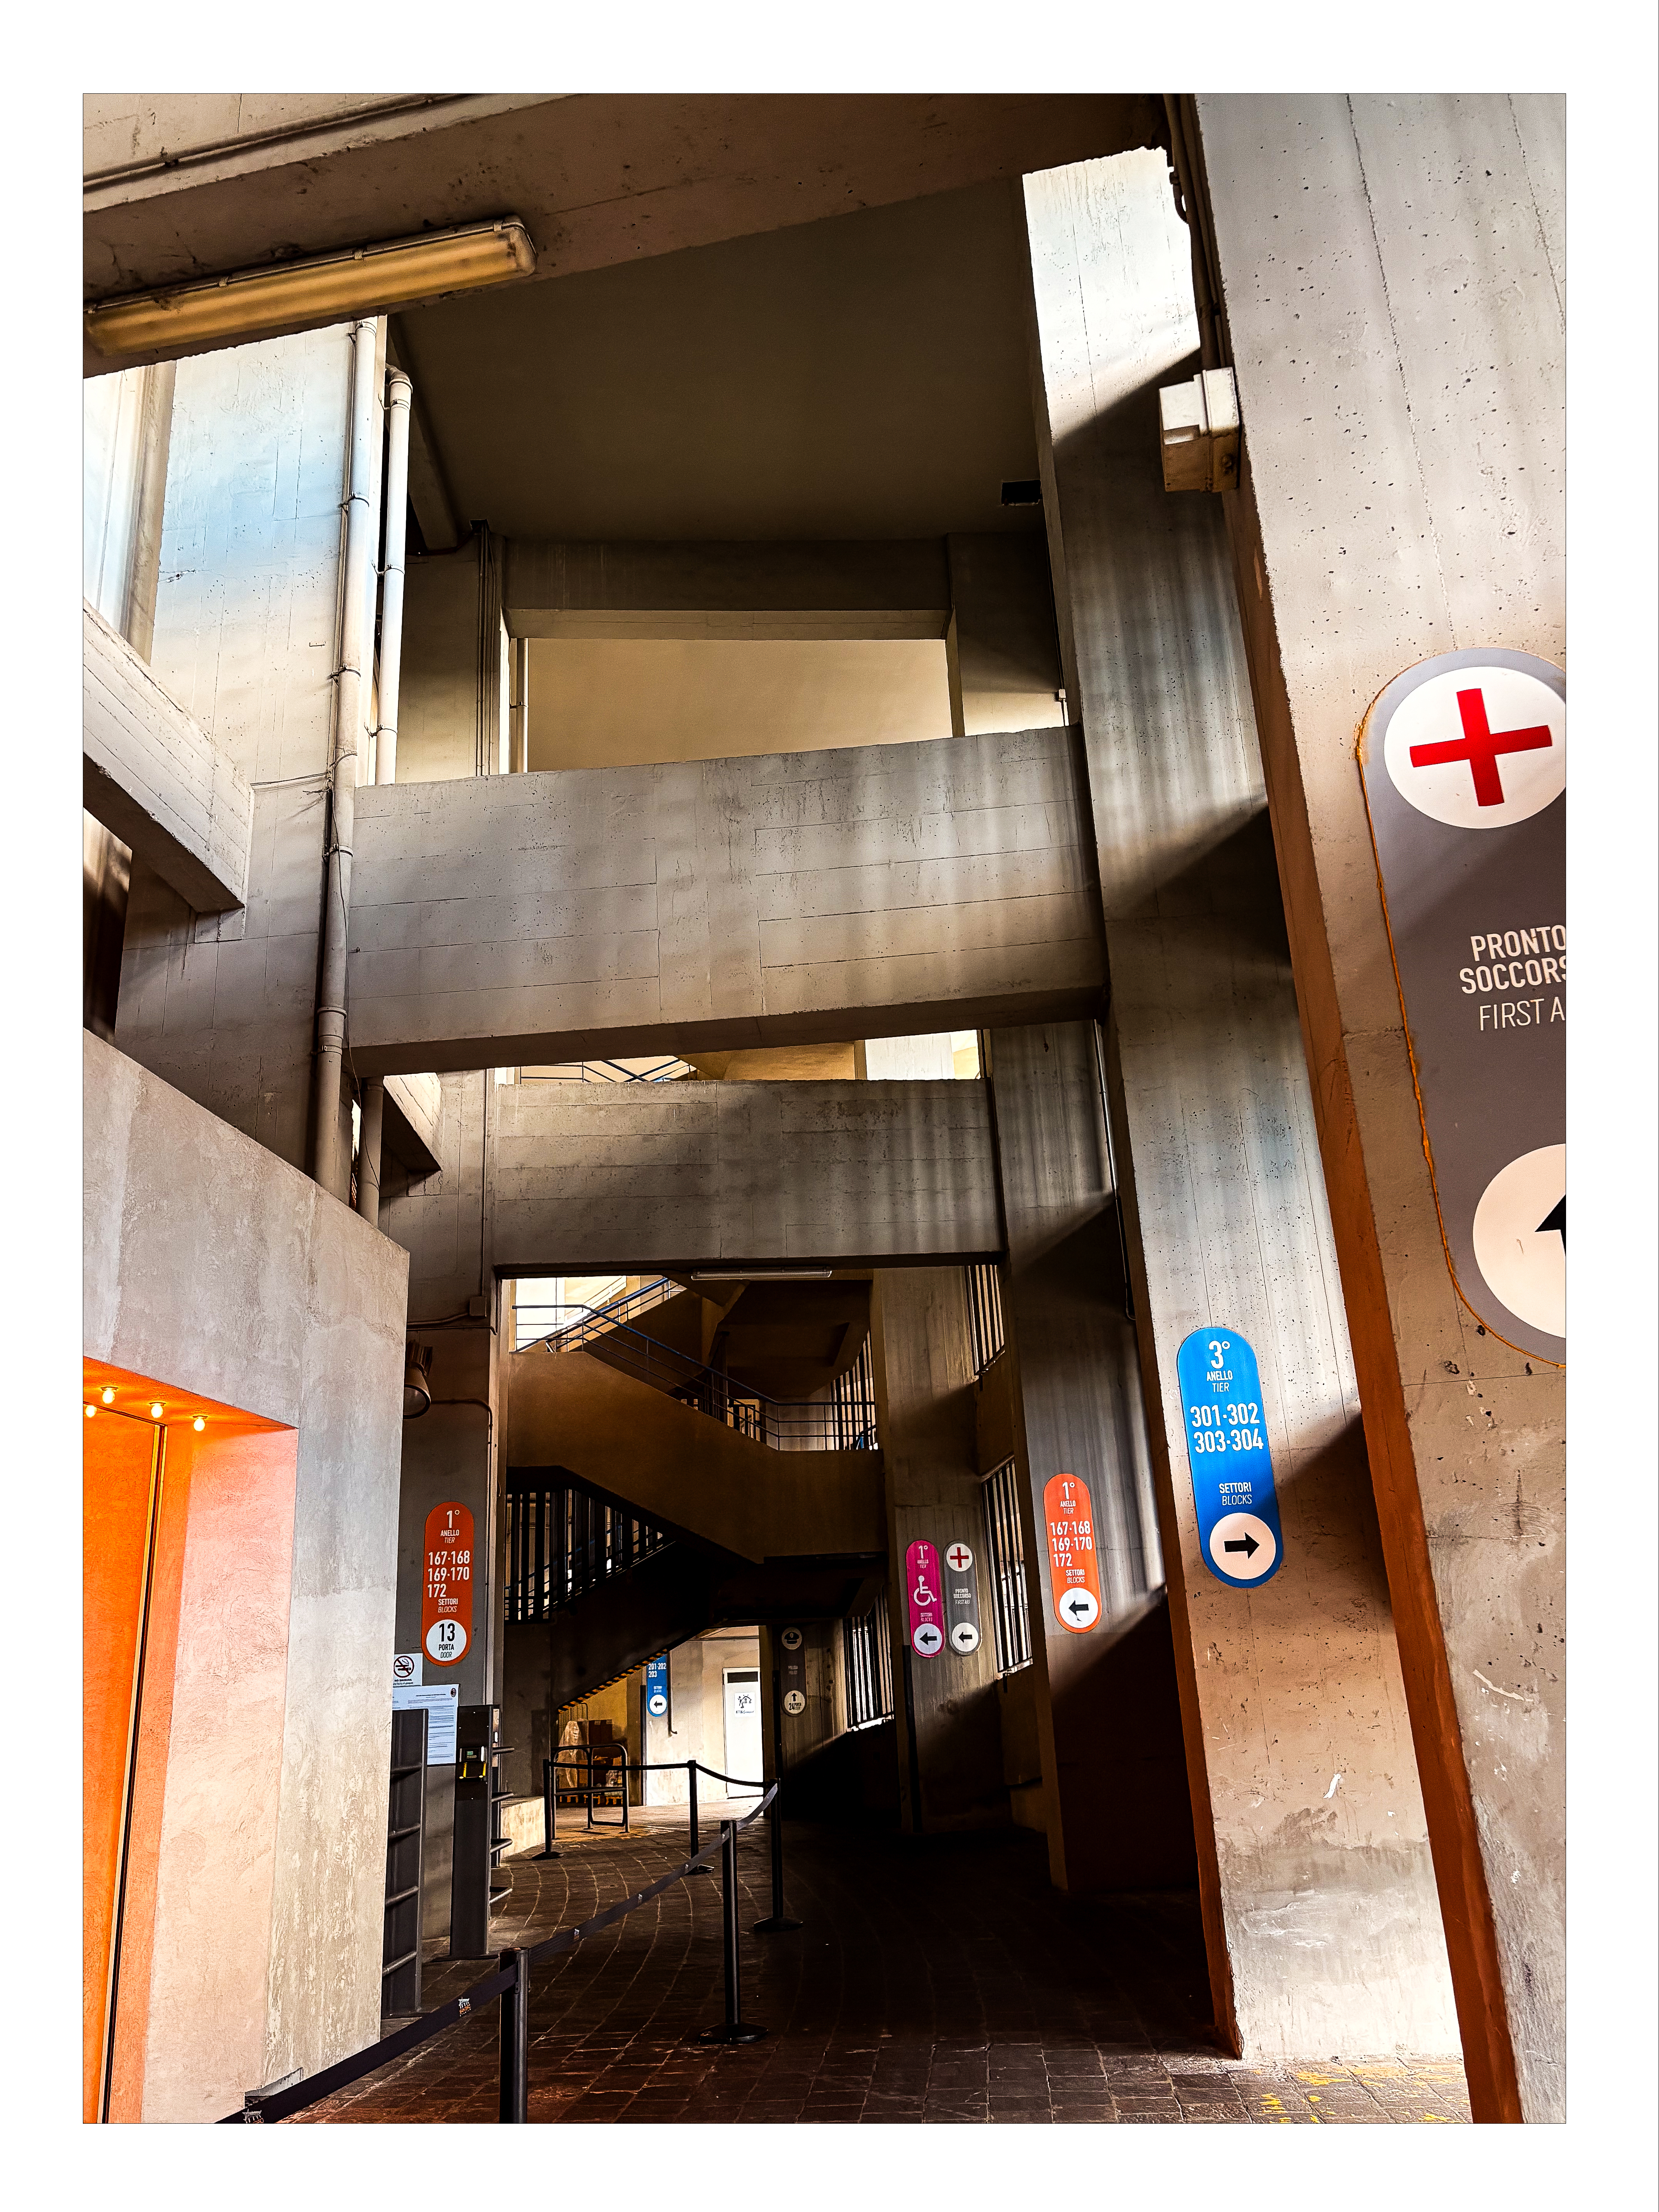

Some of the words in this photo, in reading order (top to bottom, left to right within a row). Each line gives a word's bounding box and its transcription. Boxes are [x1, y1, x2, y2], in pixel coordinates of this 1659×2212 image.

[1470, 925, 1566, 961] PRONTO
[1480, 998, 1544, 1031] FIRST
[1209, 1340, 1231, 1369] 3°
[1207, 1370, 1233, 1381] ANELLO
[1212, 1382, 1230, 1393] TIER
[1219, 1482, 1252, 1494] SETTORI
[1222, 1494, 1252, 1506] BLOCKS
[447, 1510, 460, 1528] 1°
[1053, 1553, 1073, 1567] 172
[428, 1583, 447, 1598] 172
[439, 1623, 455, 1642] 13
